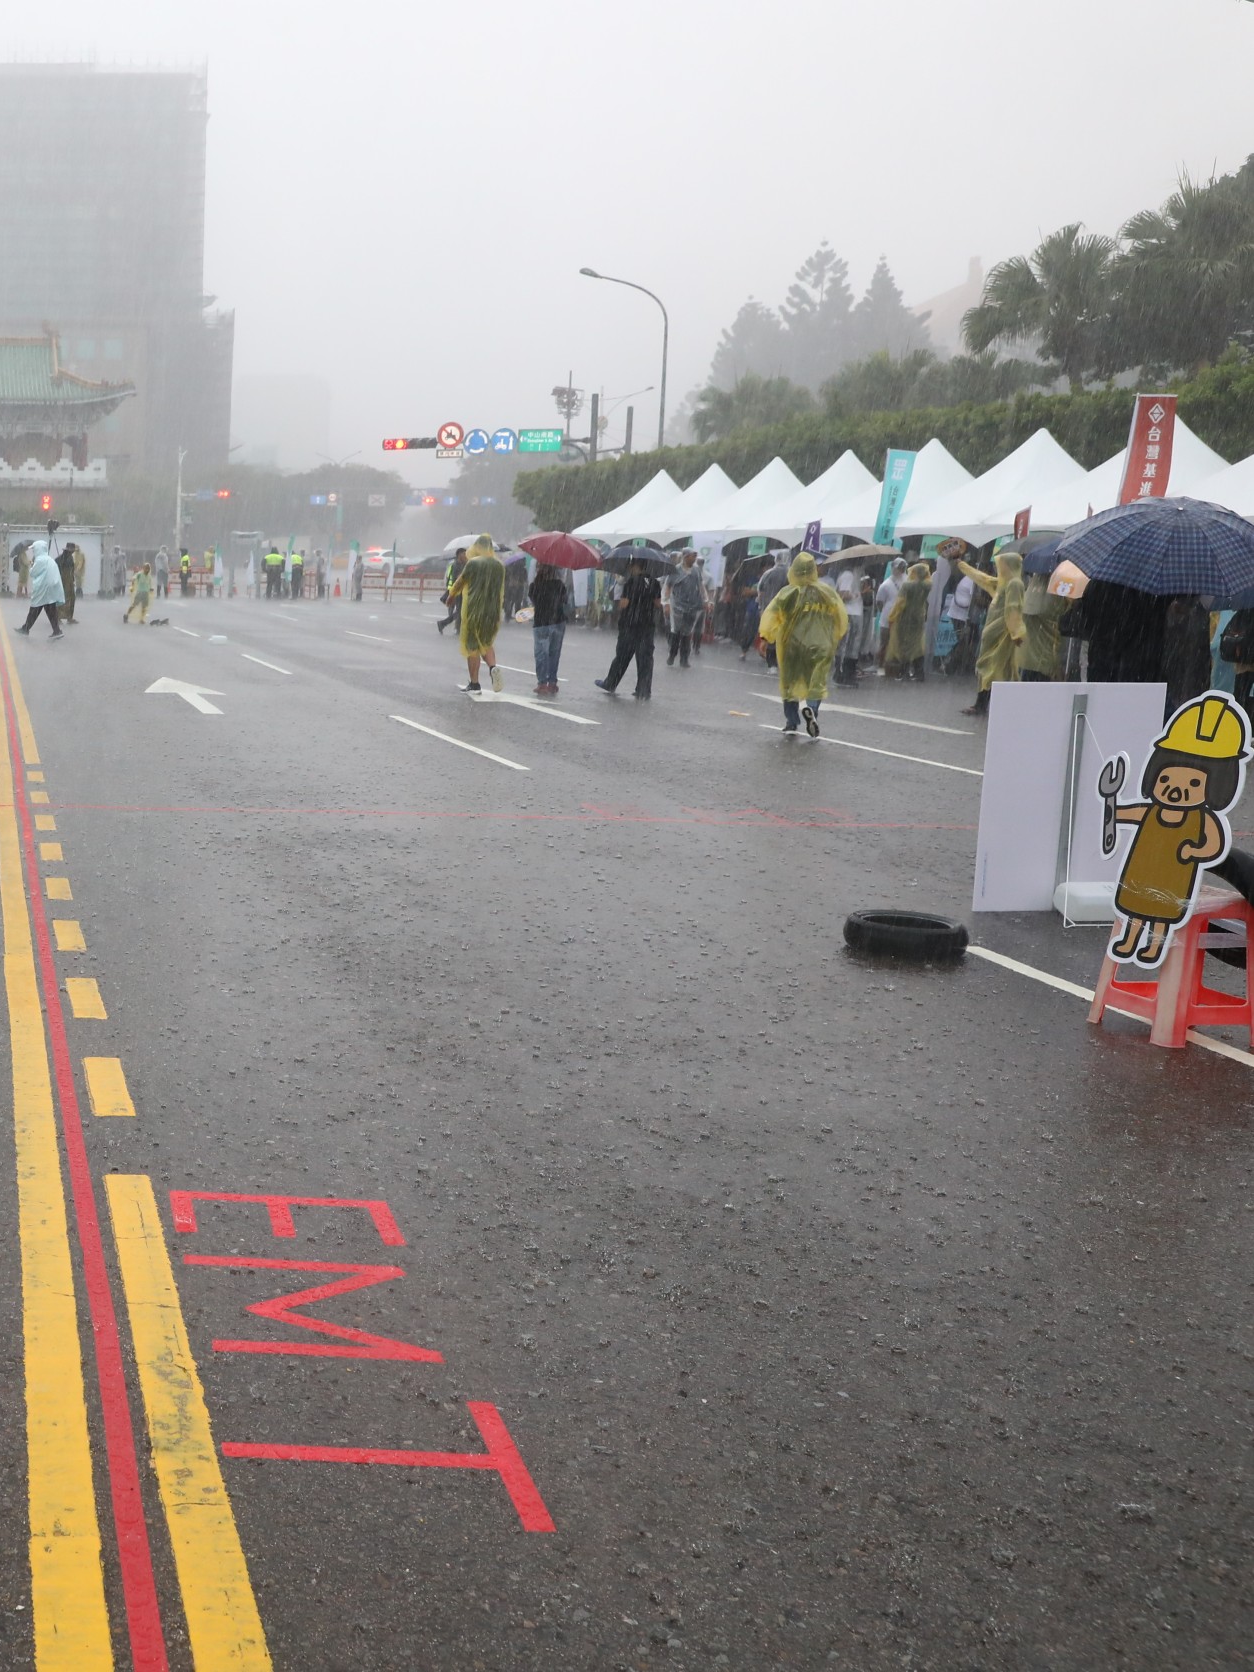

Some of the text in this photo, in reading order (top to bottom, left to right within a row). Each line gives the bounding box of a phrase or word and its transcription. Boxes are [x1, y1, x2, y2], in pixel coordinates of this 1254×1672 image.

[1137, 426, 1162, 496] 台灣基進
[170, 1190, 555, 1533] EMT
